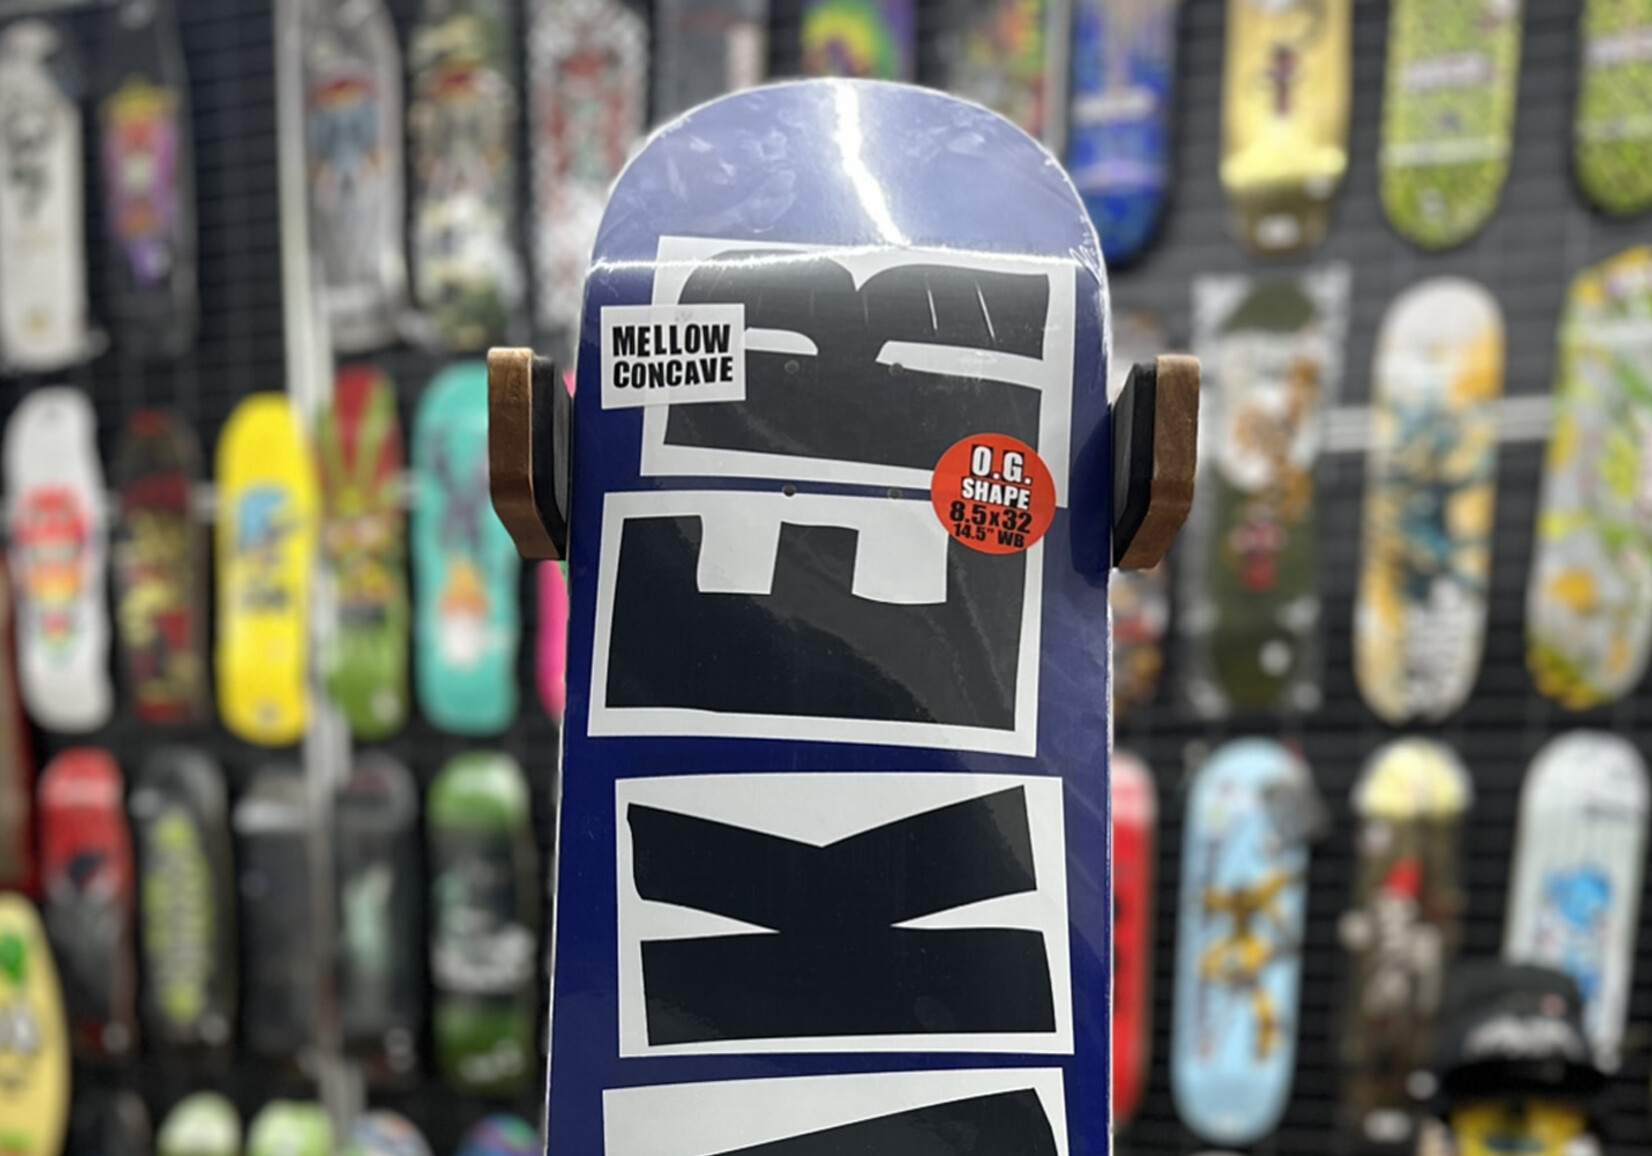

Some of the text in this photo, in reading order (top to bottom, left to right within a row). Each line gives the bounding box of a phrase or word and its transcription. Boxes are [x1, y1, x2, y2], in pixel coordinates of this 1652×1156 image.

[612, 323, 731, 358] MELLOW
[613, 356, 734, 389] CONCAVE
[971, 445, 1032, 485] O.G.
[961, 477, 1031, 510] SHAPE
[997, 529, 1025, 548] WB
